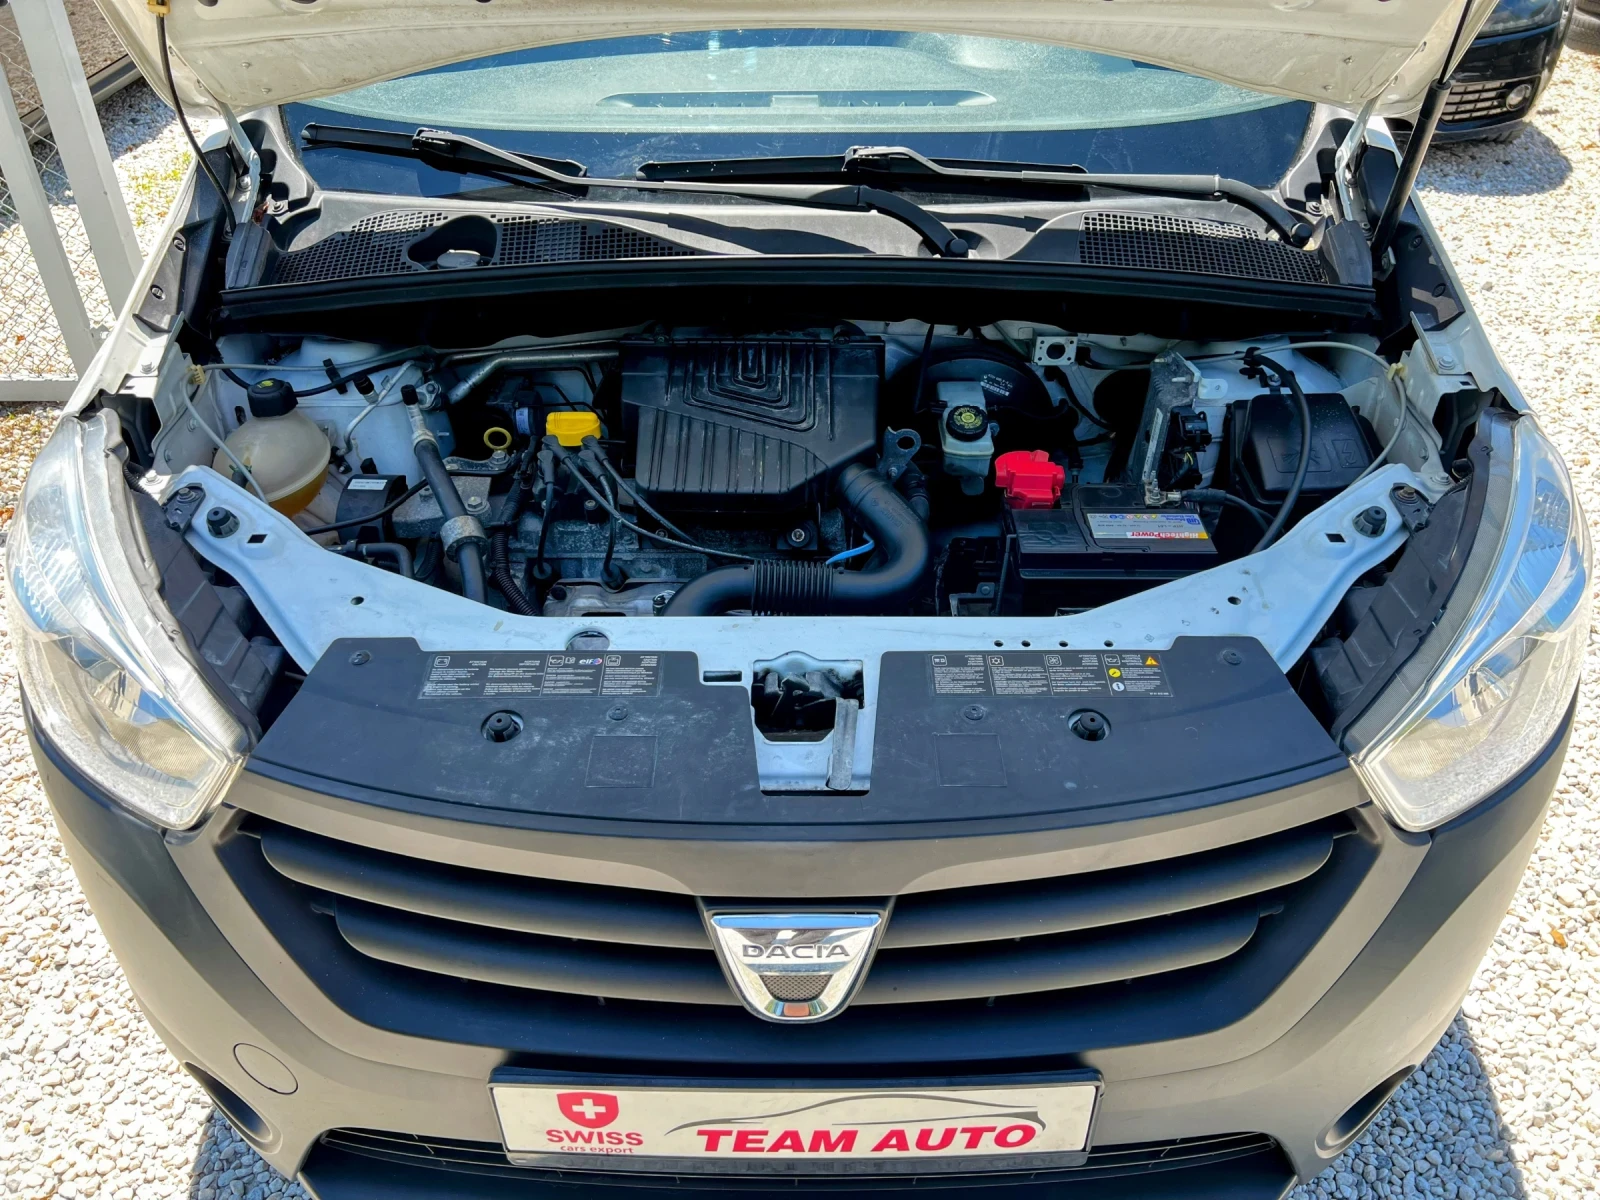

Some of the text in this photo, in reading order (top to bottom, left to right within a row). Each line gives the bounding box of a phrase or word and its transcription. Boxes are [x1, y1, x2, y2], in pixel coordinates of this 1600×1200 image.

[742, 944, 850, 959] DACIA
[545, 1129, 644, 1146] SWISS
[697, 1124, 1037, 1154] TEAM AUTO
[560, 1145, 634, 1155] cars export
